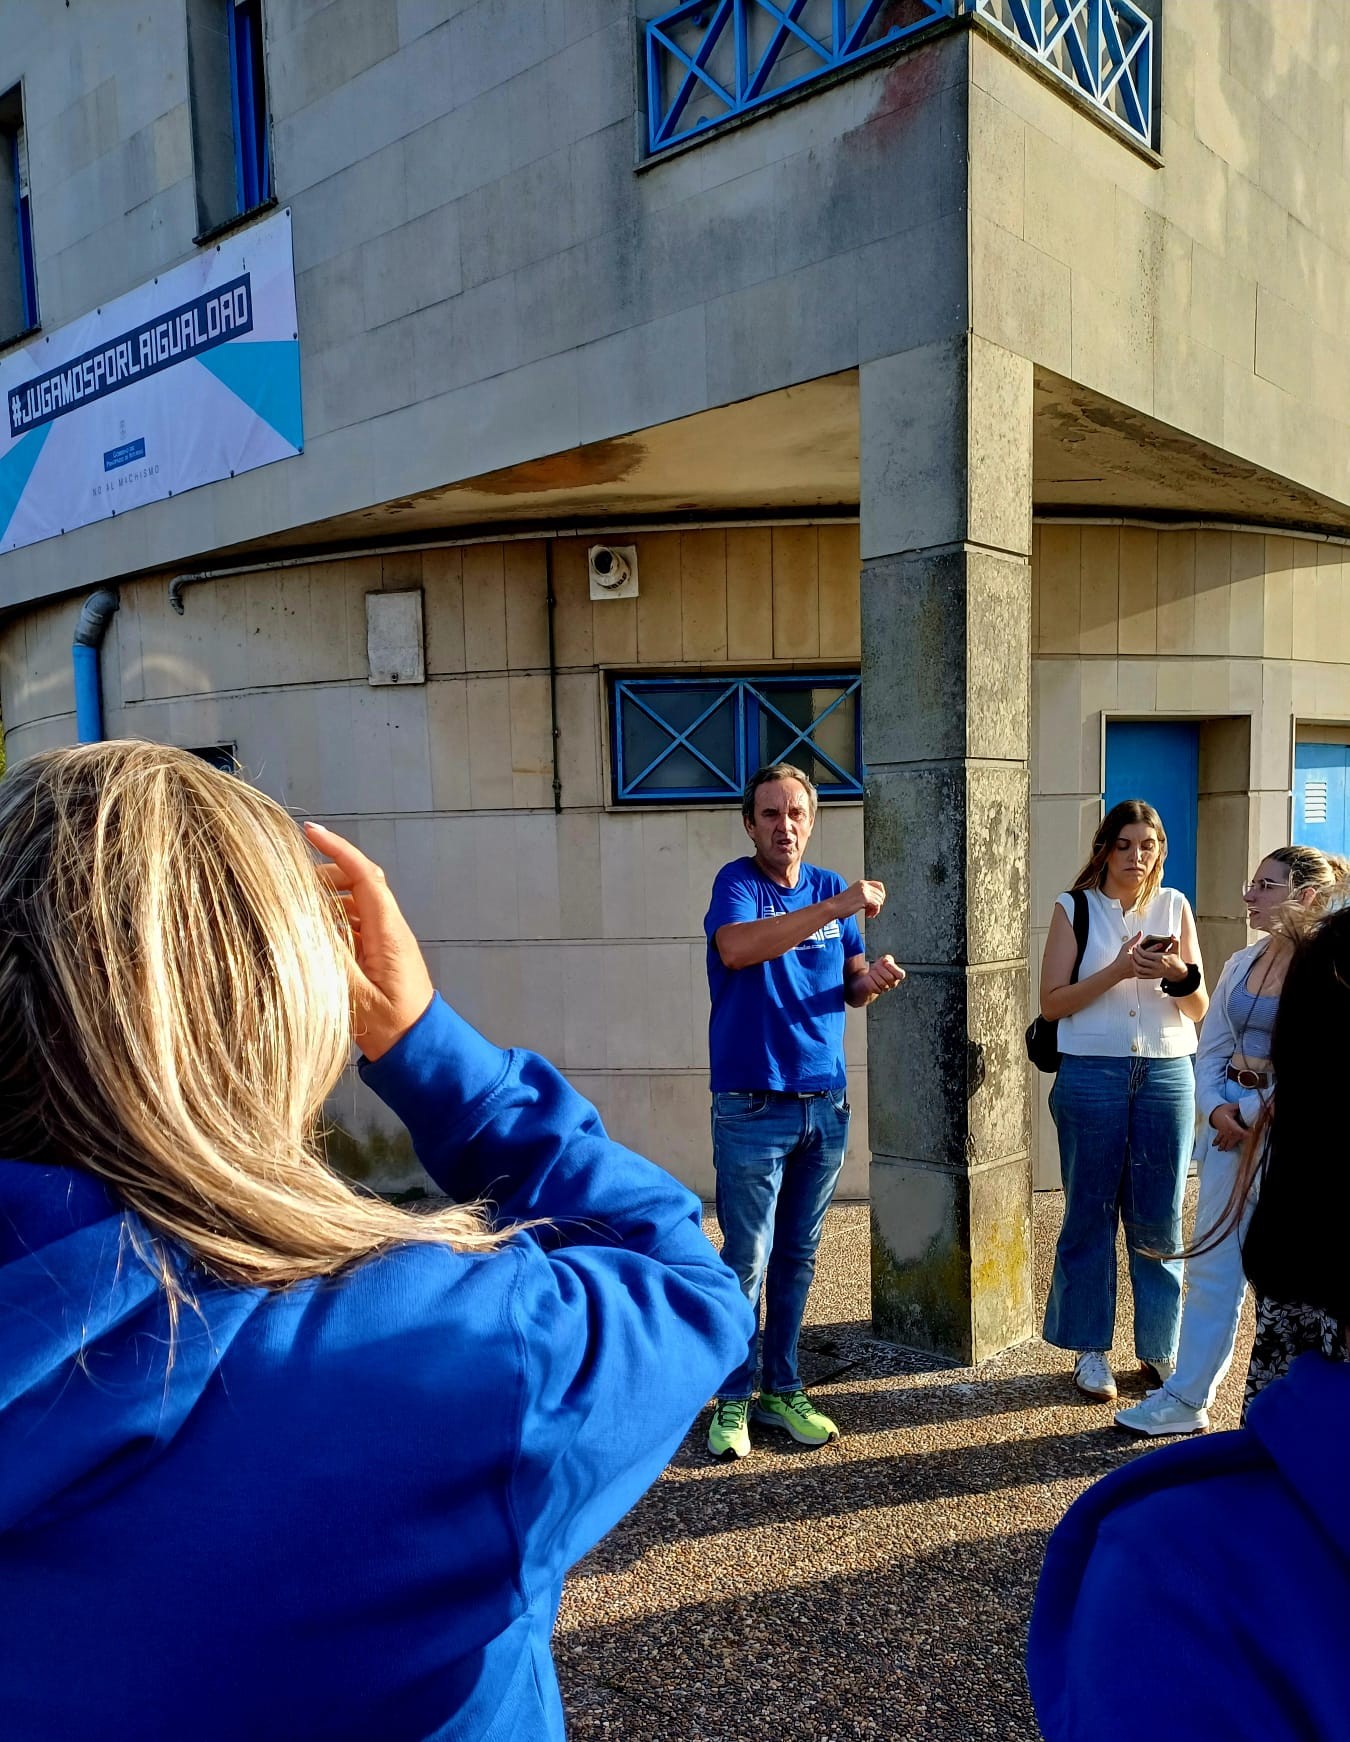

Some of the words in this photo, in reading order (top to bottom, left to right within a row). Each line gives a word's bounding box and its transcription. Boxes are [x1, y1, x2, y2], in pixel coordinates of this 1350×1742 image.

[11, 286, 248, 427] #JUGAMOSPORLAIGUALDAD
[92, 486, 102, 496] NO
[106, 482, 114, 491] AL
[118, 464, 160, 487] MACHISMO
